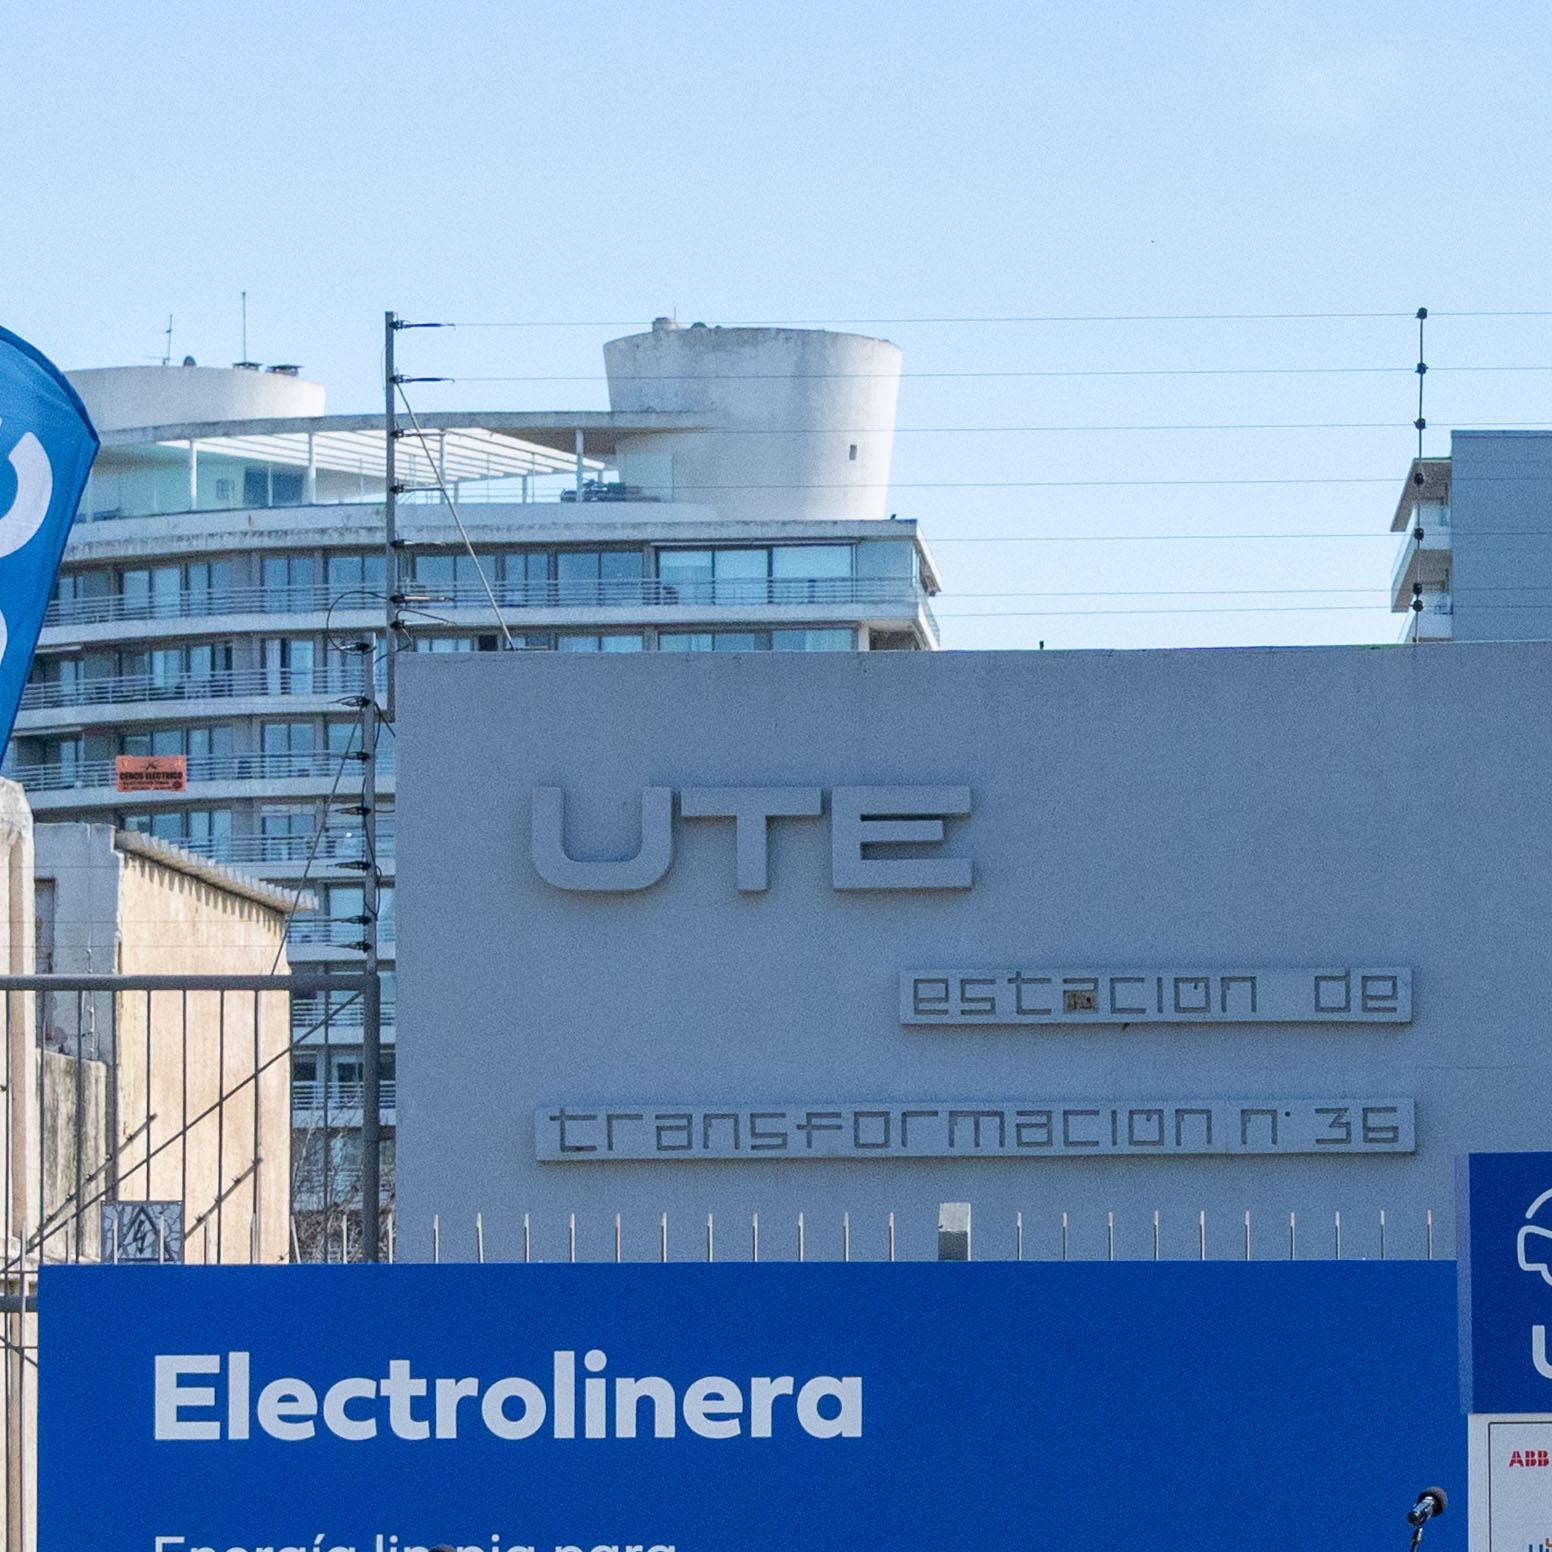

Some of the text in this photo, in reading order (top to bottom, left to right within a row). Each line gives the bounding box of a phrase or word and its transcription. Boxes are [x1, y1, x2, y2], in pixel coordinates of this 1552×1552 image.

[531, 785, 974, 893] UTE
[1314, 968, 1399, 1014] de
[1314, 1106, 1400, 1144] 36
[154, 1350, 864, 1442] Electrolinera
[1509, 1450, 1550, 1468] ABB
